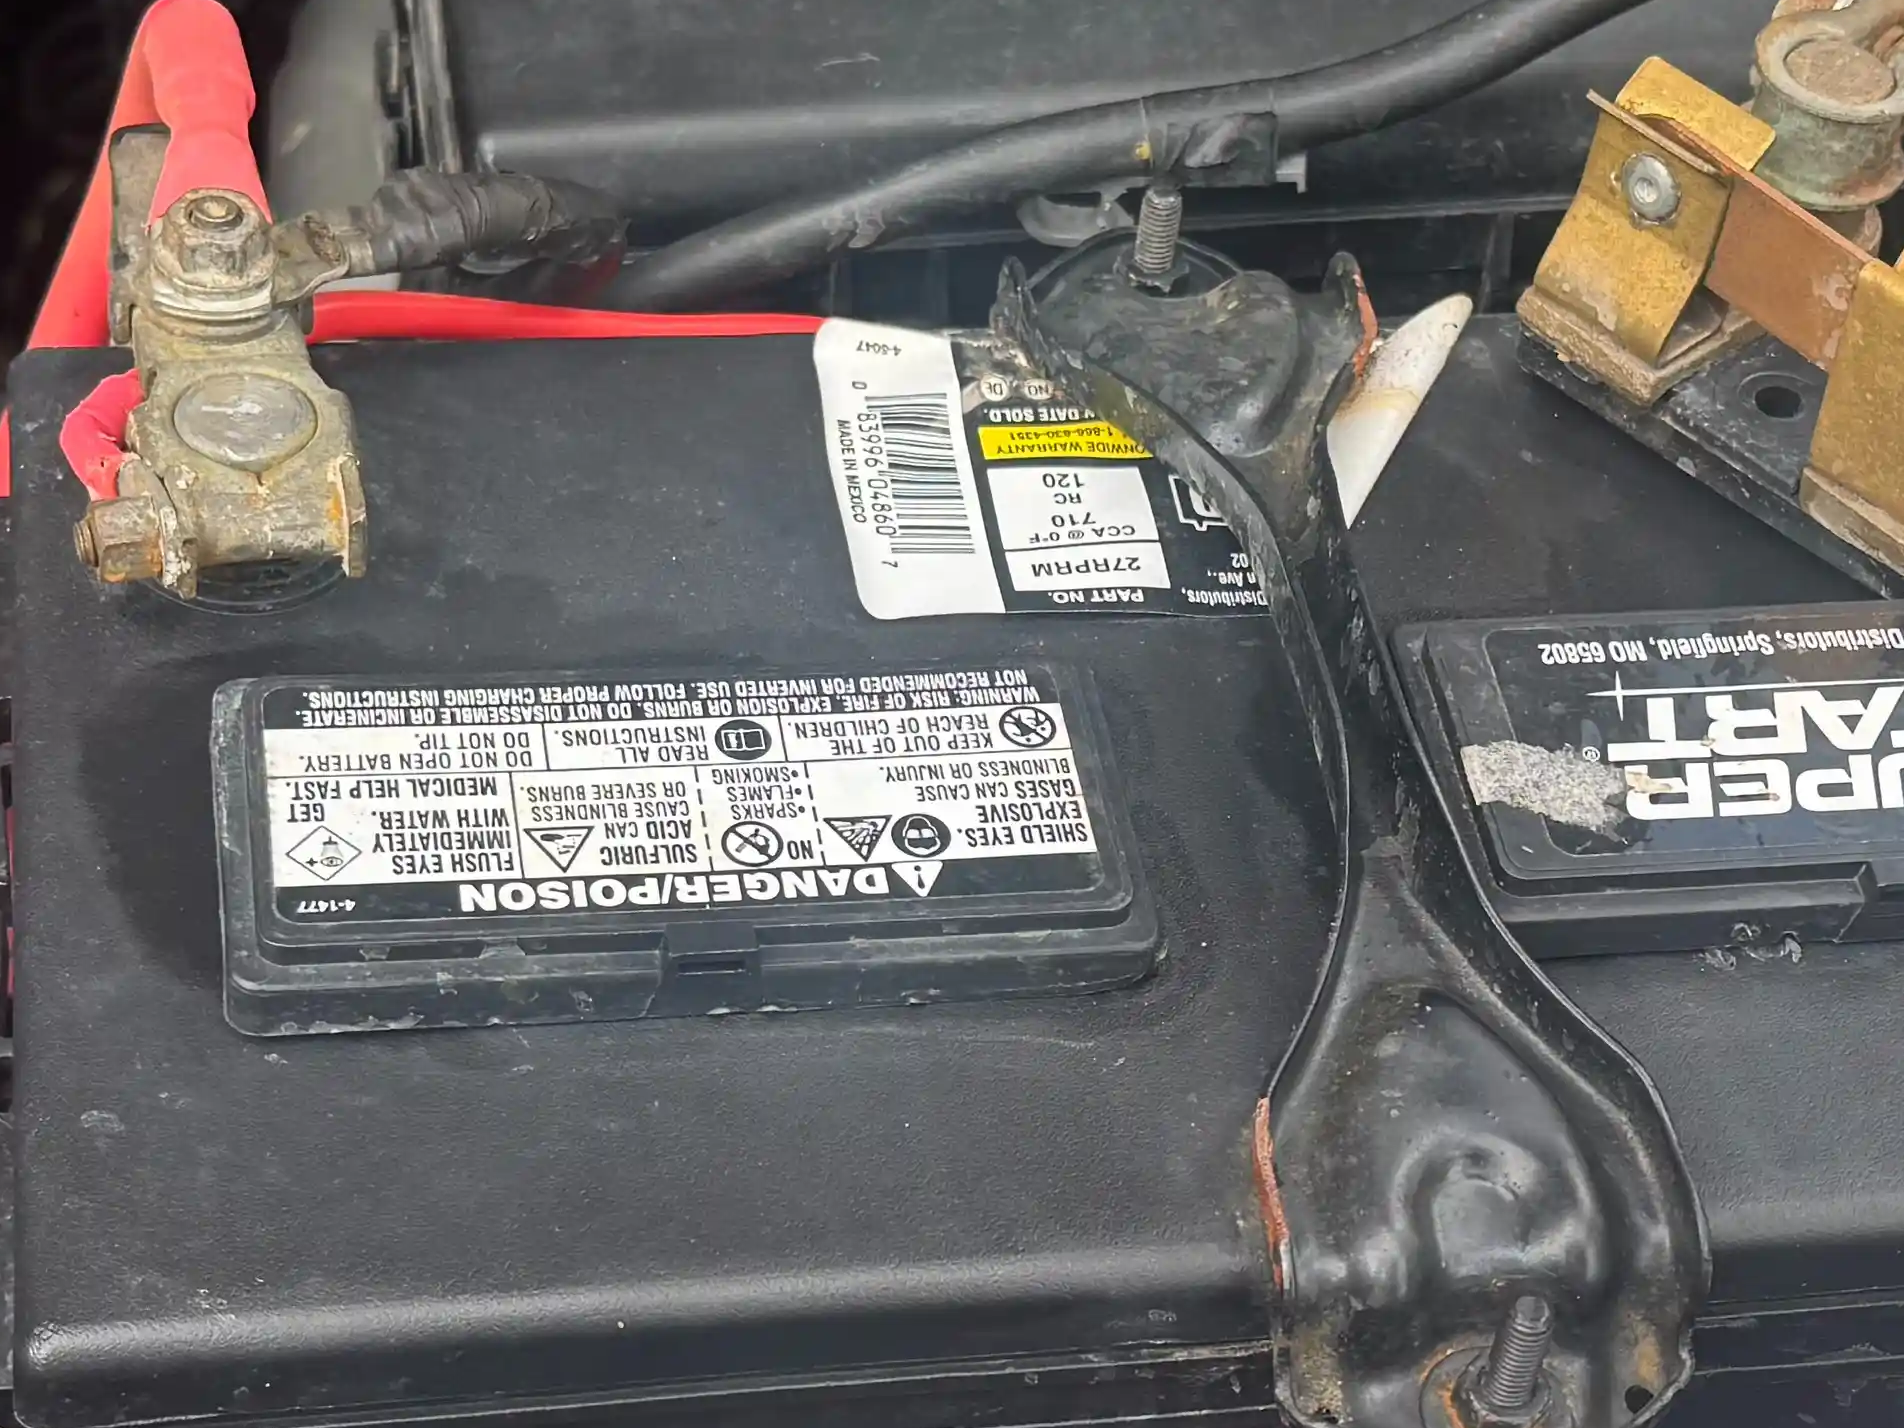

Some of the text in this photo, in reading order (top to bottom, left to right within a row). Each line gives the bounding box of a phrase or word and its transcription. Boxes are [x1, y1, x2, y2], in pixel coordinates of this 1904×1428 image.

[983, 409, 1034, 422] SOLD.
[1039, 409, 1078, 421] DATE
[857, 413, 883, 468] 83996
[996, 441, 1145, 454] ONWIDE WARRANTY
[836, 419, 867, 522] MADE IN MEXICO
[1042, 473, 1084, 488] 120
[867, 478, 896, 536] 04860
[1054, 493, 1081, 504] RC
[1051, 512, 1096, 527] 710
[1067, 530, 1084, 540] @
[1092, 525, 1136, 538] CCA
[1031, 557, 1140, 577] 27RPRM
[1048, 589, 1143, 604] PART NO.
[1649, 629, 1772, 659] Springfield,
[1774, 625, 1903, 653] Distributors,
[1537, 640, 1605, 667] 65802
[1607, 638, 1646, 664] MO
[302, 668, 1028, 709] NOT RECOMMENDED FOR INVERTED USE. FOLLOW PROPER CHARGING INSTRUCTIONS.
[910, 690, 949, 707] RISK
[953, 684, 1040, 704] WARNING:
[638, 700, 703, 719] BURNS.
[707, 700, 732, 717] OR
[737, 696, 830, 714] EXPLOSION
[882, 693, 906, 708] OF
[295, 708, 405, 727] INCINERATE.
[409, 707, 435, 724] OR
[439, 704, 561, 724] DISASSEMBLE
[562, 704, 602, 720] NOT
[607, 703, 632, 719] DO
[553, 725, 705, 747] INSTRUCTIONS.
[787, 713, 988, 739] REACH OF CHILDREN.
[414, 732, 529, 751] DO NOT TIP.
[829, 732, 993, 755] KEEP OUT OF THE
[298, 750, 532, 773] DO NOT OPEN BATTERY.
[615, 745, 707, 764] READ ALL
[879, 758, 1070, 782] BLINDNESS OR INJURY.
[285, 776, 497, 801] MEDICAL HELP FAST.
[519, 781, 686, 803] OR SEVERE BURNS.
[915, 779, 1076, 802] GASES CAN CAUSE
[287, 802, 324, 823] GET
[371, 807, 509, 829] WITH WATER.
[531, 800, 689, 823] CAUSE BLINDNESS
[975, 801, 1081, 822] EXPLOSIVE
[604, 820, 692, 839] ACID CAN
[956, 823, 1088, 846] SHIELD EYES.
[372, 830, 511, 853] IMMEDIATELY
[787, 839, 813, 859] NO
[392, 851, 514, 875] FLUSH EYES
[599, 843, 697, 866] SULFURIC
[459, 866, 890, 912] DANGER/POISON
[298, 898, 356, 913] 4-1477
